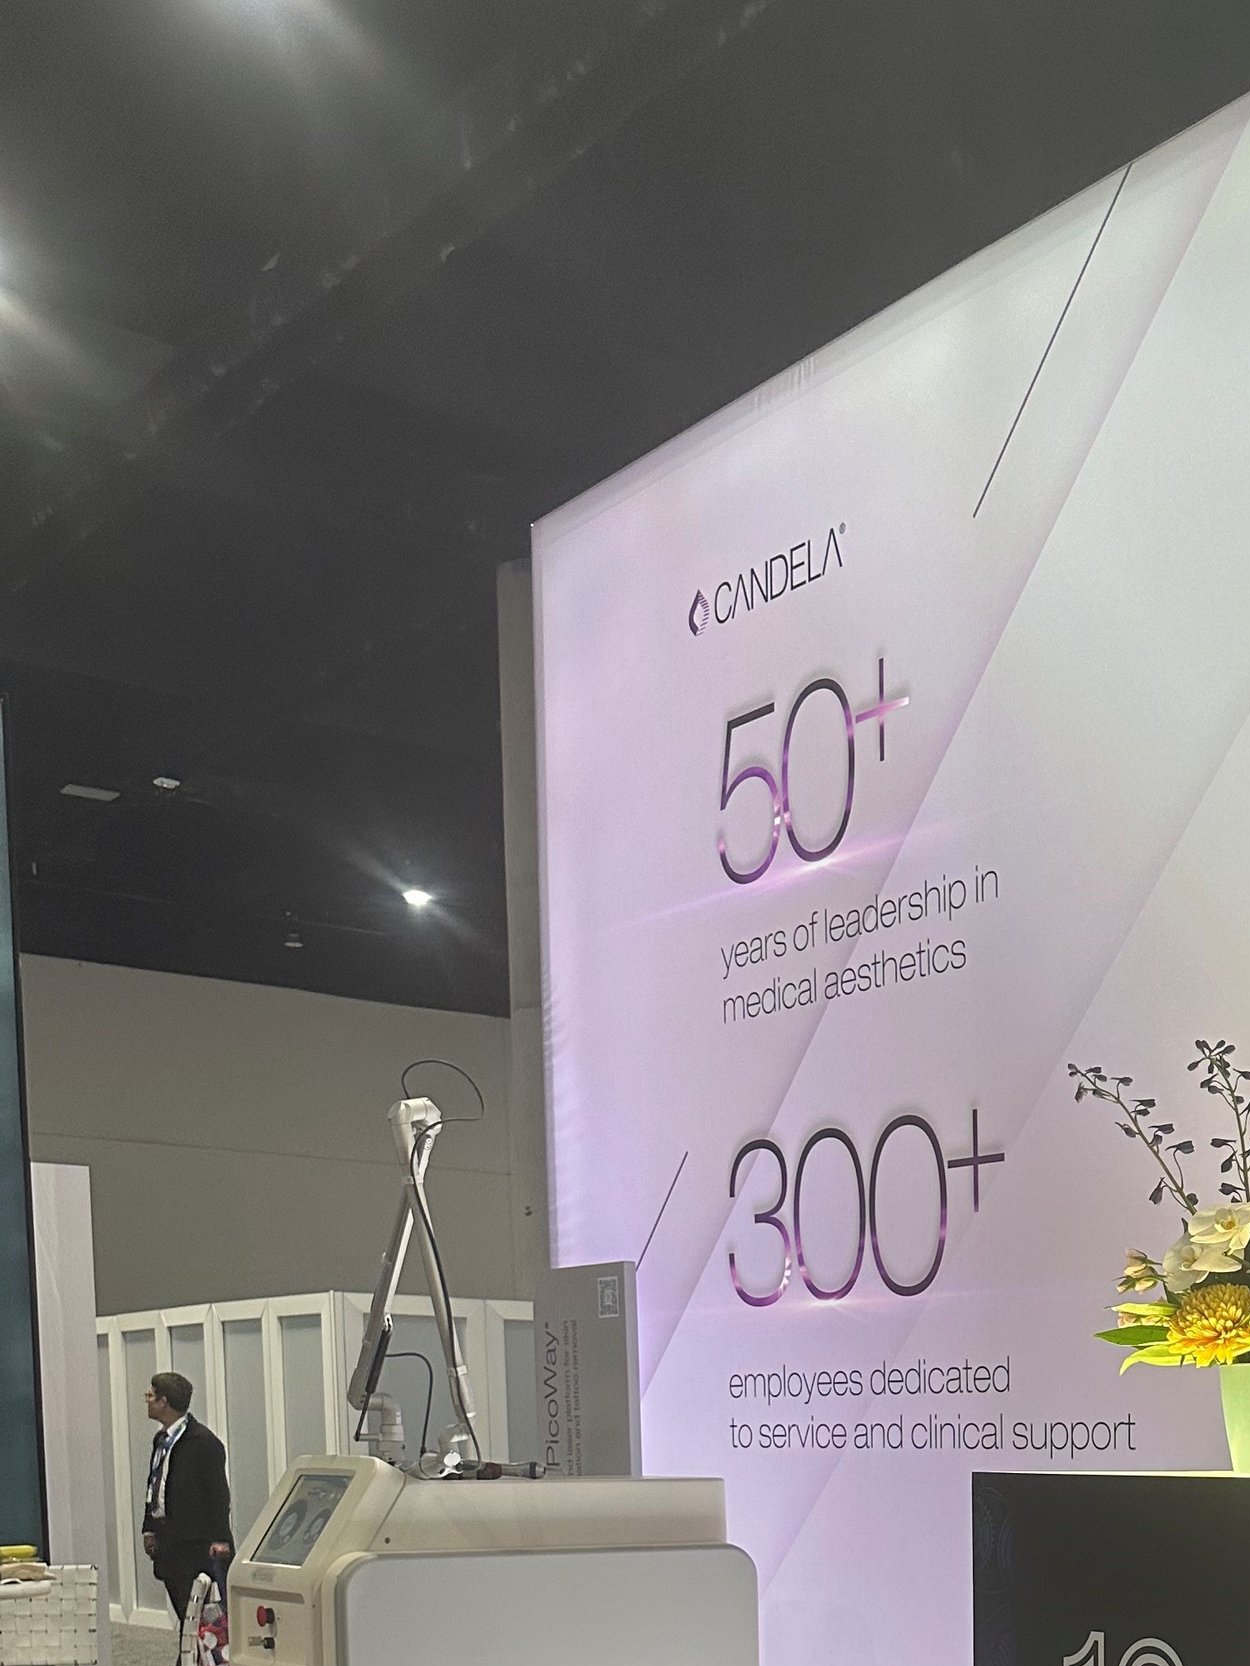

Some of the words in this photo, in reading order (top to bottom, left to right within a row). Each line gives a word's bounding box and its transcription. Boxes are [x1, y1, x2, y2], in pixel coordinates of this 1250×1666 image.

[718, 657, 910, 885] 50+
[720, 930, 788, 981] years
[792, 910, 819, 952] of
[824, 873, 967, 944] leadership
[975, 864, 999, 904] in
[723, 967, 818, 1025] medical
[823, 937, 967, 1001] aesthetics
[728, 1108, 1006, 1308] 300+
[728, 1363, 864, 1407] employees
[869, 1355, 1011, 1396] dedicated
[729, 1417, 753, 1449] to
[758, 1414, 848, 1450] service
[853, 1413, 904, 1450] and
[910, 1412, 1004, 1451] clinical
[1011, 1412, 1137, 1461] support
